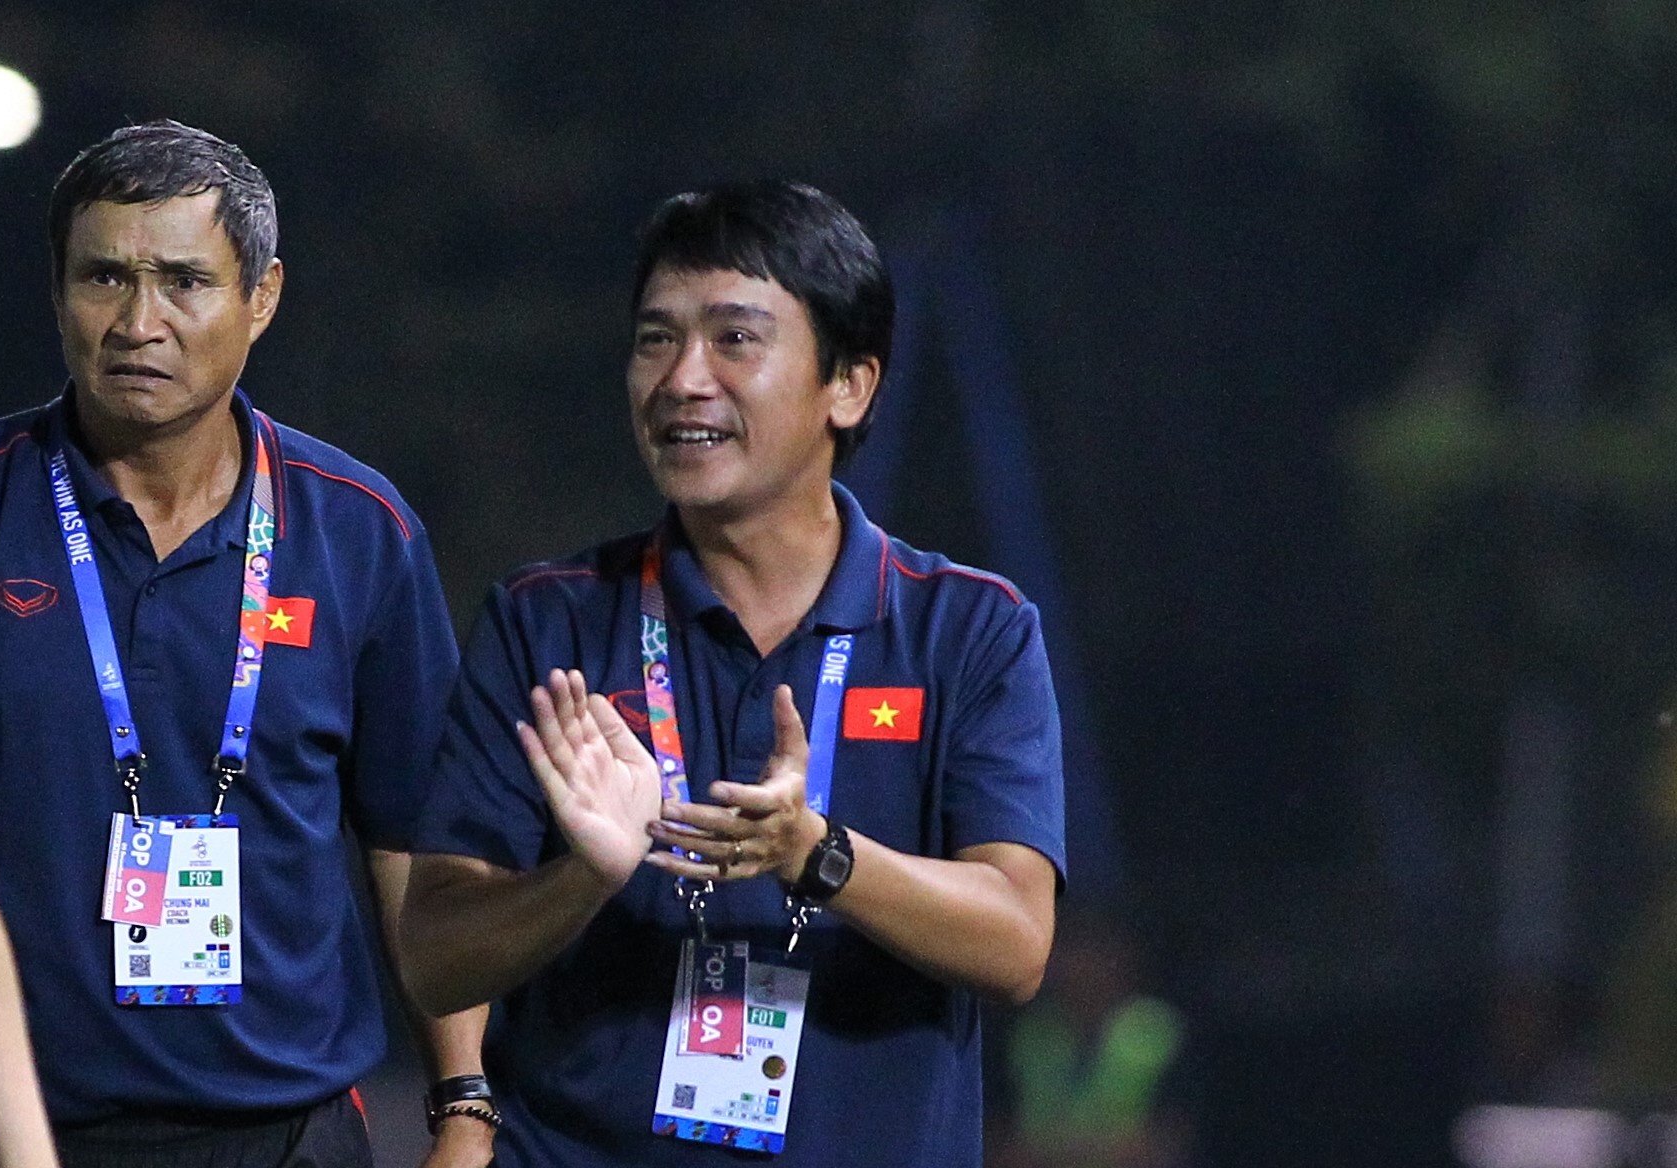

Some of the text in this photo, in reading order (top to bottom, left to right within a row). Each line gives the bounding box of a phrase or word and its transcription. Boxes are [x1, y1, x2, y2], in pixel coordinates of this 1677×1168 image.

[53, 474, 76, 508] WIN
[60, 510, 83, 531] AS
[66, 532, 92, 566] ONE
[822, 634, 852, 686] S ONE
[123, 878, 146, 913] OA
[700, 1005, 723, 1043] OA
